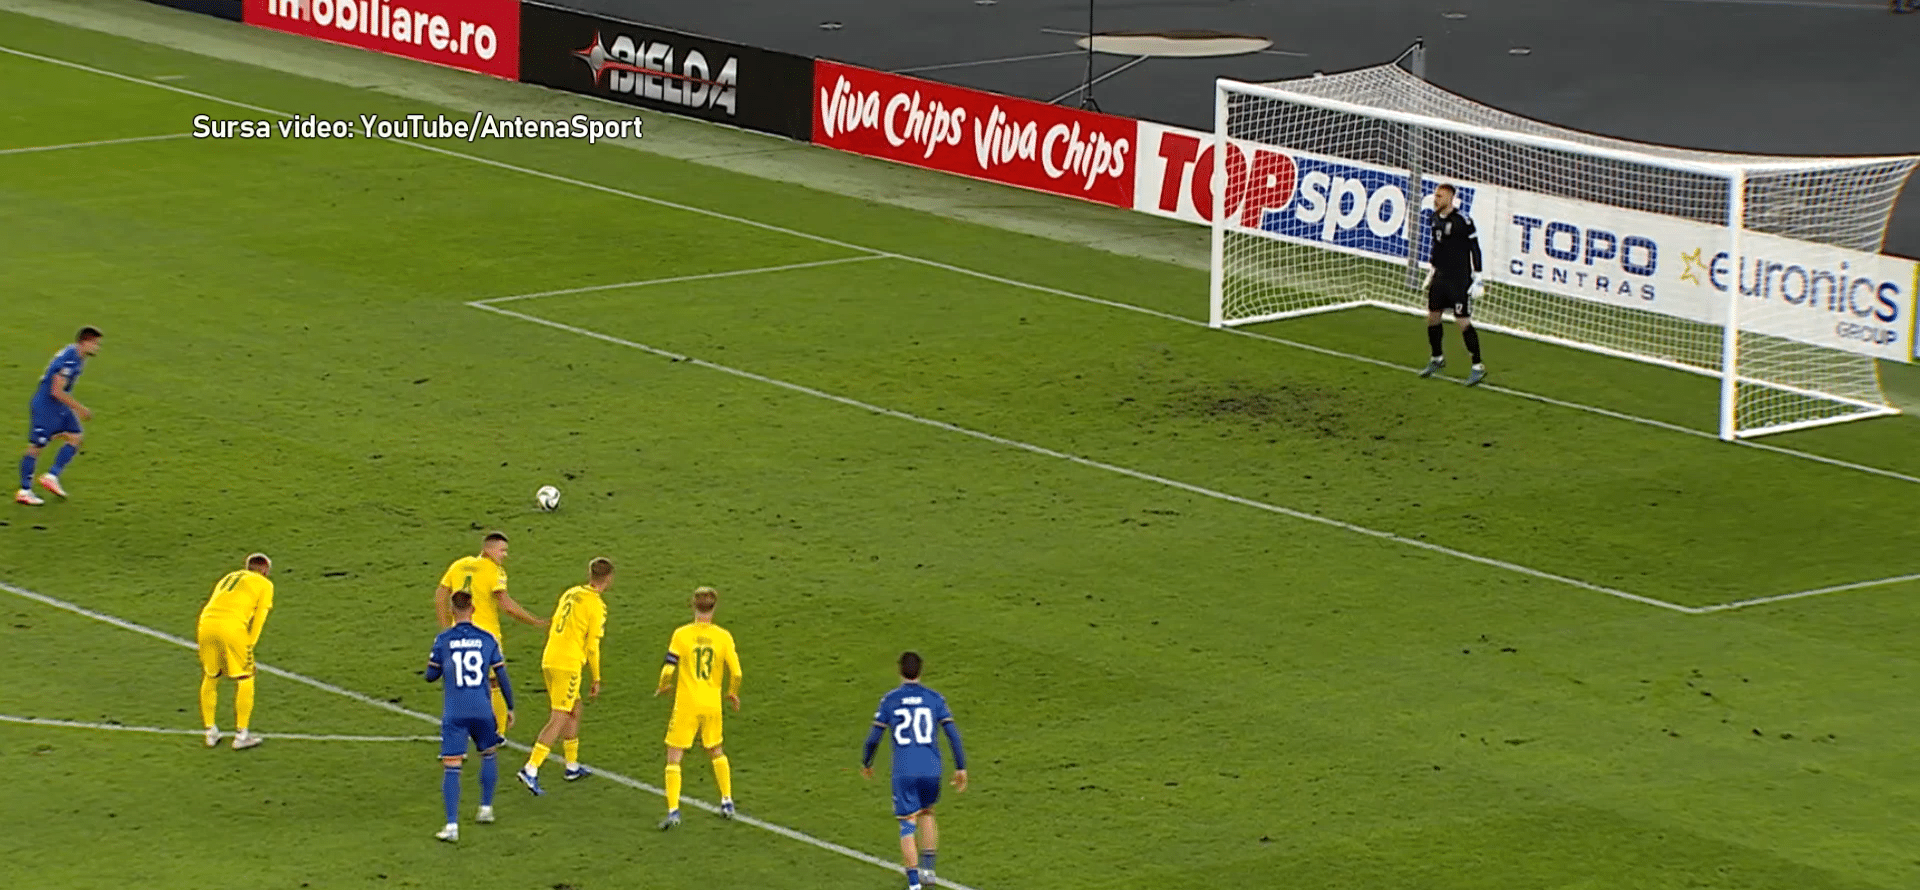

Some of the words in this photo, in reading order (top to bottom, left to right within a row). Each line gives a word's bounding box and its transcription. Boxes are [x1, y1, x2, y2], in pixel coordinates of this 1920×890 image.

[610, 35, 738, 116] BIELDA
[821, 75, 879, 138] Viva
[884, 90, 966, 159] Chips
[974, 105, 1037, 170] Viva
[1041, 121, 1129, 190] Chips
[1512, 214, 1657, 277] TOPO
[1509, 259, 1655, 301] CENTRAS
[1709, 252, 1900, 323] euronics
[452, 650, 483, 687] 19
[693, 647, 714, 680] 13
[894, 707, 933, 745] 20
